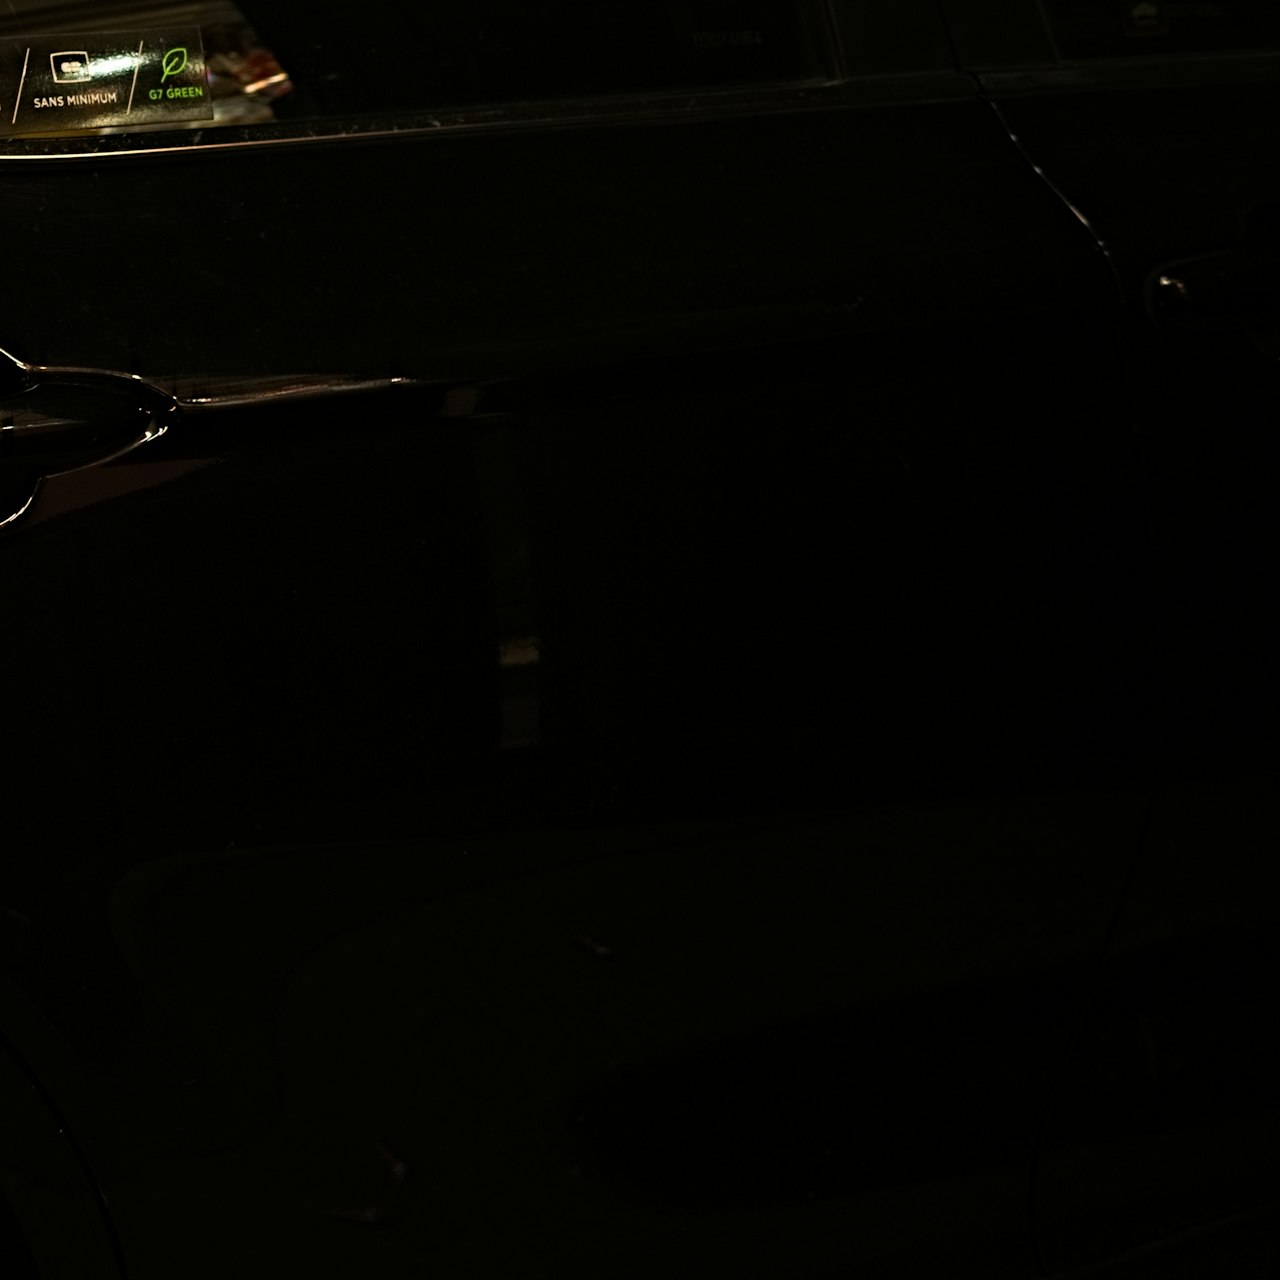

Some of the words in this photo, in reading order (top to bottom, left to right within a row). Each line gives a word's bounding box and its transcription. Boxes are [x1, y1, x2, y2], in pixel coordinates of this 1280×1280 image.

[33, 94, 65, 109] SANS
[66, 92, 117, 106] MINIMUM
[148, 89, 163, 101] G7
[165, 86, 203, 99] GREEN
